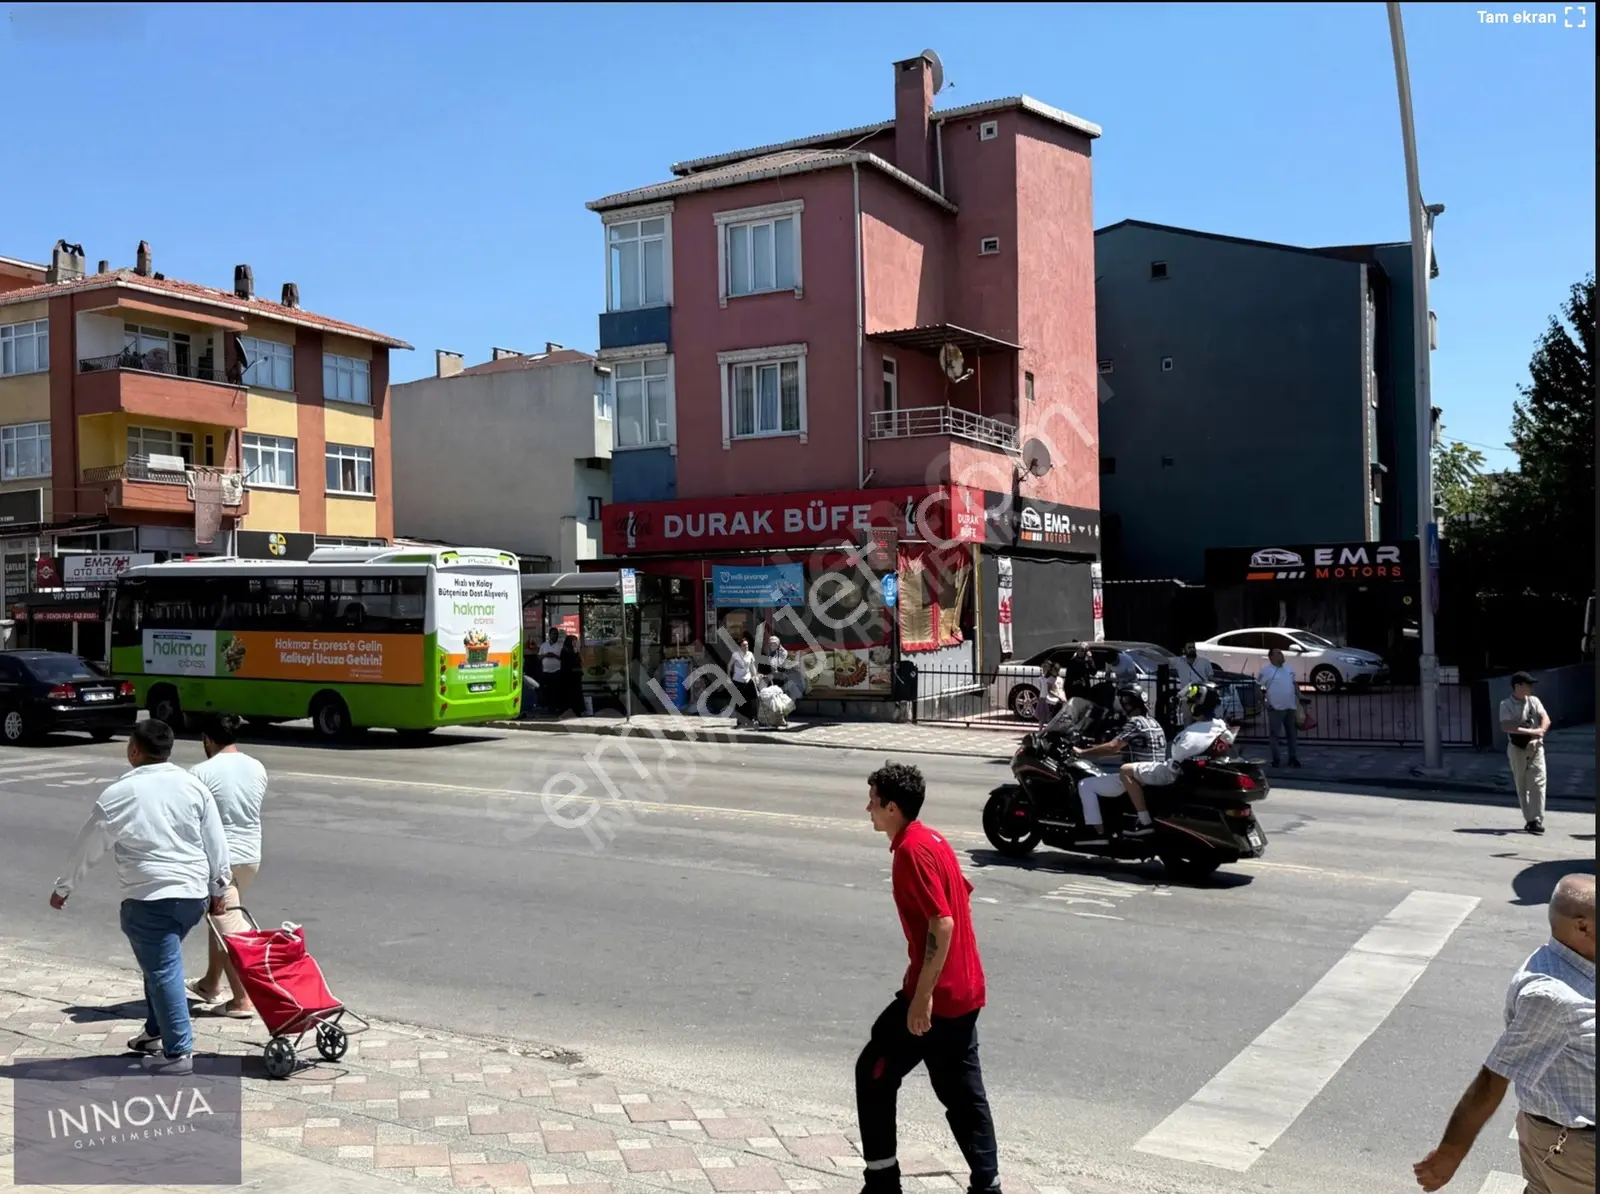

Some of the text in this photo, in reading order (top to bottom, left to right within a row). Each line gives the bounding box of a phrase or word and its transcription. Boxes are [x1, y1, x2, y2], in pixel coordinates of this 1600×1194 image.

[664, 509, 774, 538] DURAK
[784, 499, 872, 533] BÜFE
[957, 513, 979, 525] DURAK
[1044, 512, 1071, 534] EMR
[960, 525, 977, 538] BÜFE
[1045, 534, 1072, 544] MOTORS
[84, 556, 130, 568] EMRAH
[1314, 546, 1400, 566] EMR
[73, 568, 92, 576] OTO
[1315, 567, 1401, 579] MOTORS
[476, 580, 493, 589] Kolay
[66, 592, 79, 600] OTO
[438, 587, 468, 599] Bütçenize
[469, 589, 483, 597] Dost
[453, 602, 495, 616] hakmar
[152, 640, 207, 657] hakmar
[275, 638, 383, 652] Hakmar Express'e Gelin
[280, 652, 383, 666] Kaliteyi Ucuza Getirin!
